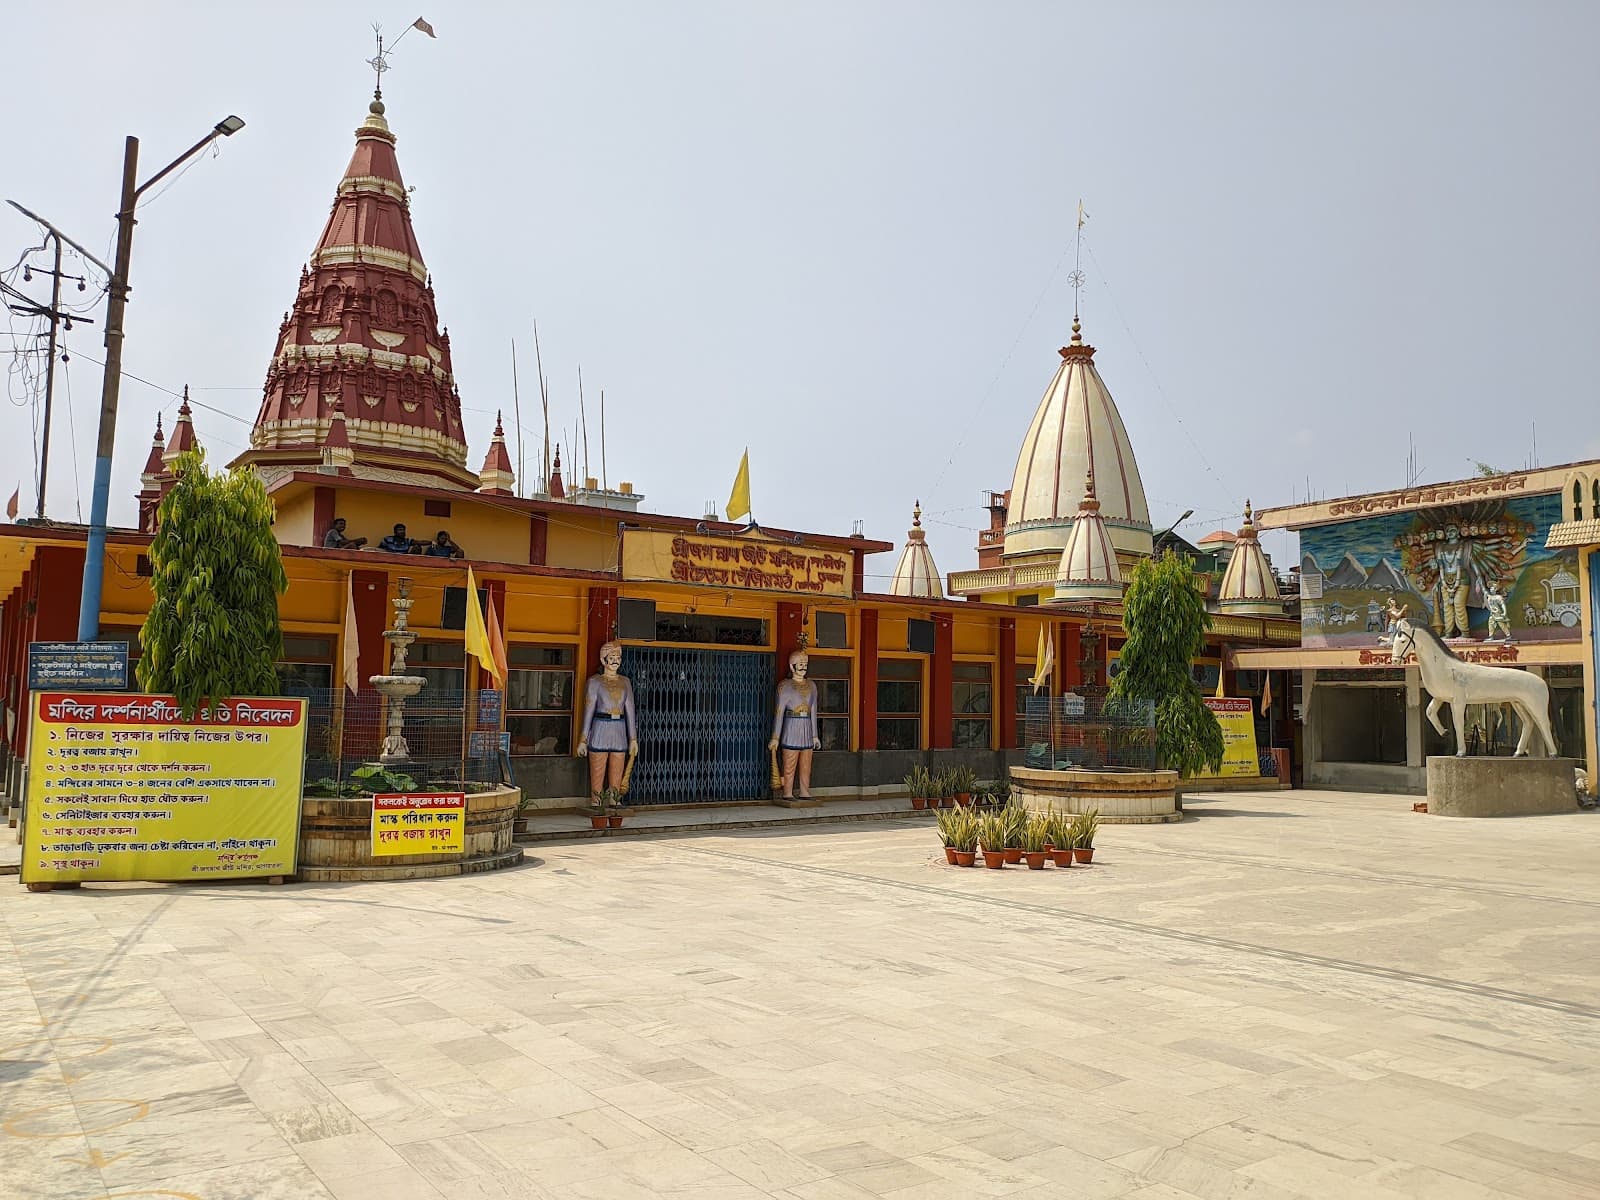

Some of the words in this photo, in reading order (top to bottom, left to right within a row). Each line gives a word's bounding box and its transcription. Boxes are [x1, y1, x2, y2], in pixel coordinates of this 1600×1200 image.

[48, 699, 97, 720] মন্দির
[236, 703, 293, 724] নিবেদন
[66, 729, 104, 741] নিজের
[194, 729, 230, 742] নিজের
[82, 747, 106, 757] বজায়
[161, 762, 180, 772] দর্শন
[147, 779, 172, 788] জনের
[112, 810, 140, 820] ব্যবহার
[379, 814, 398, 824] মাস্ক
[402, 811, 433, 824] পরিধান
[436, 813, 458, 823] করুন
[379, 830, 400, 843] দূরত্ব
[403, 830, 425, 840] বজায়
[429, 828, 451, 841] রাখুন
